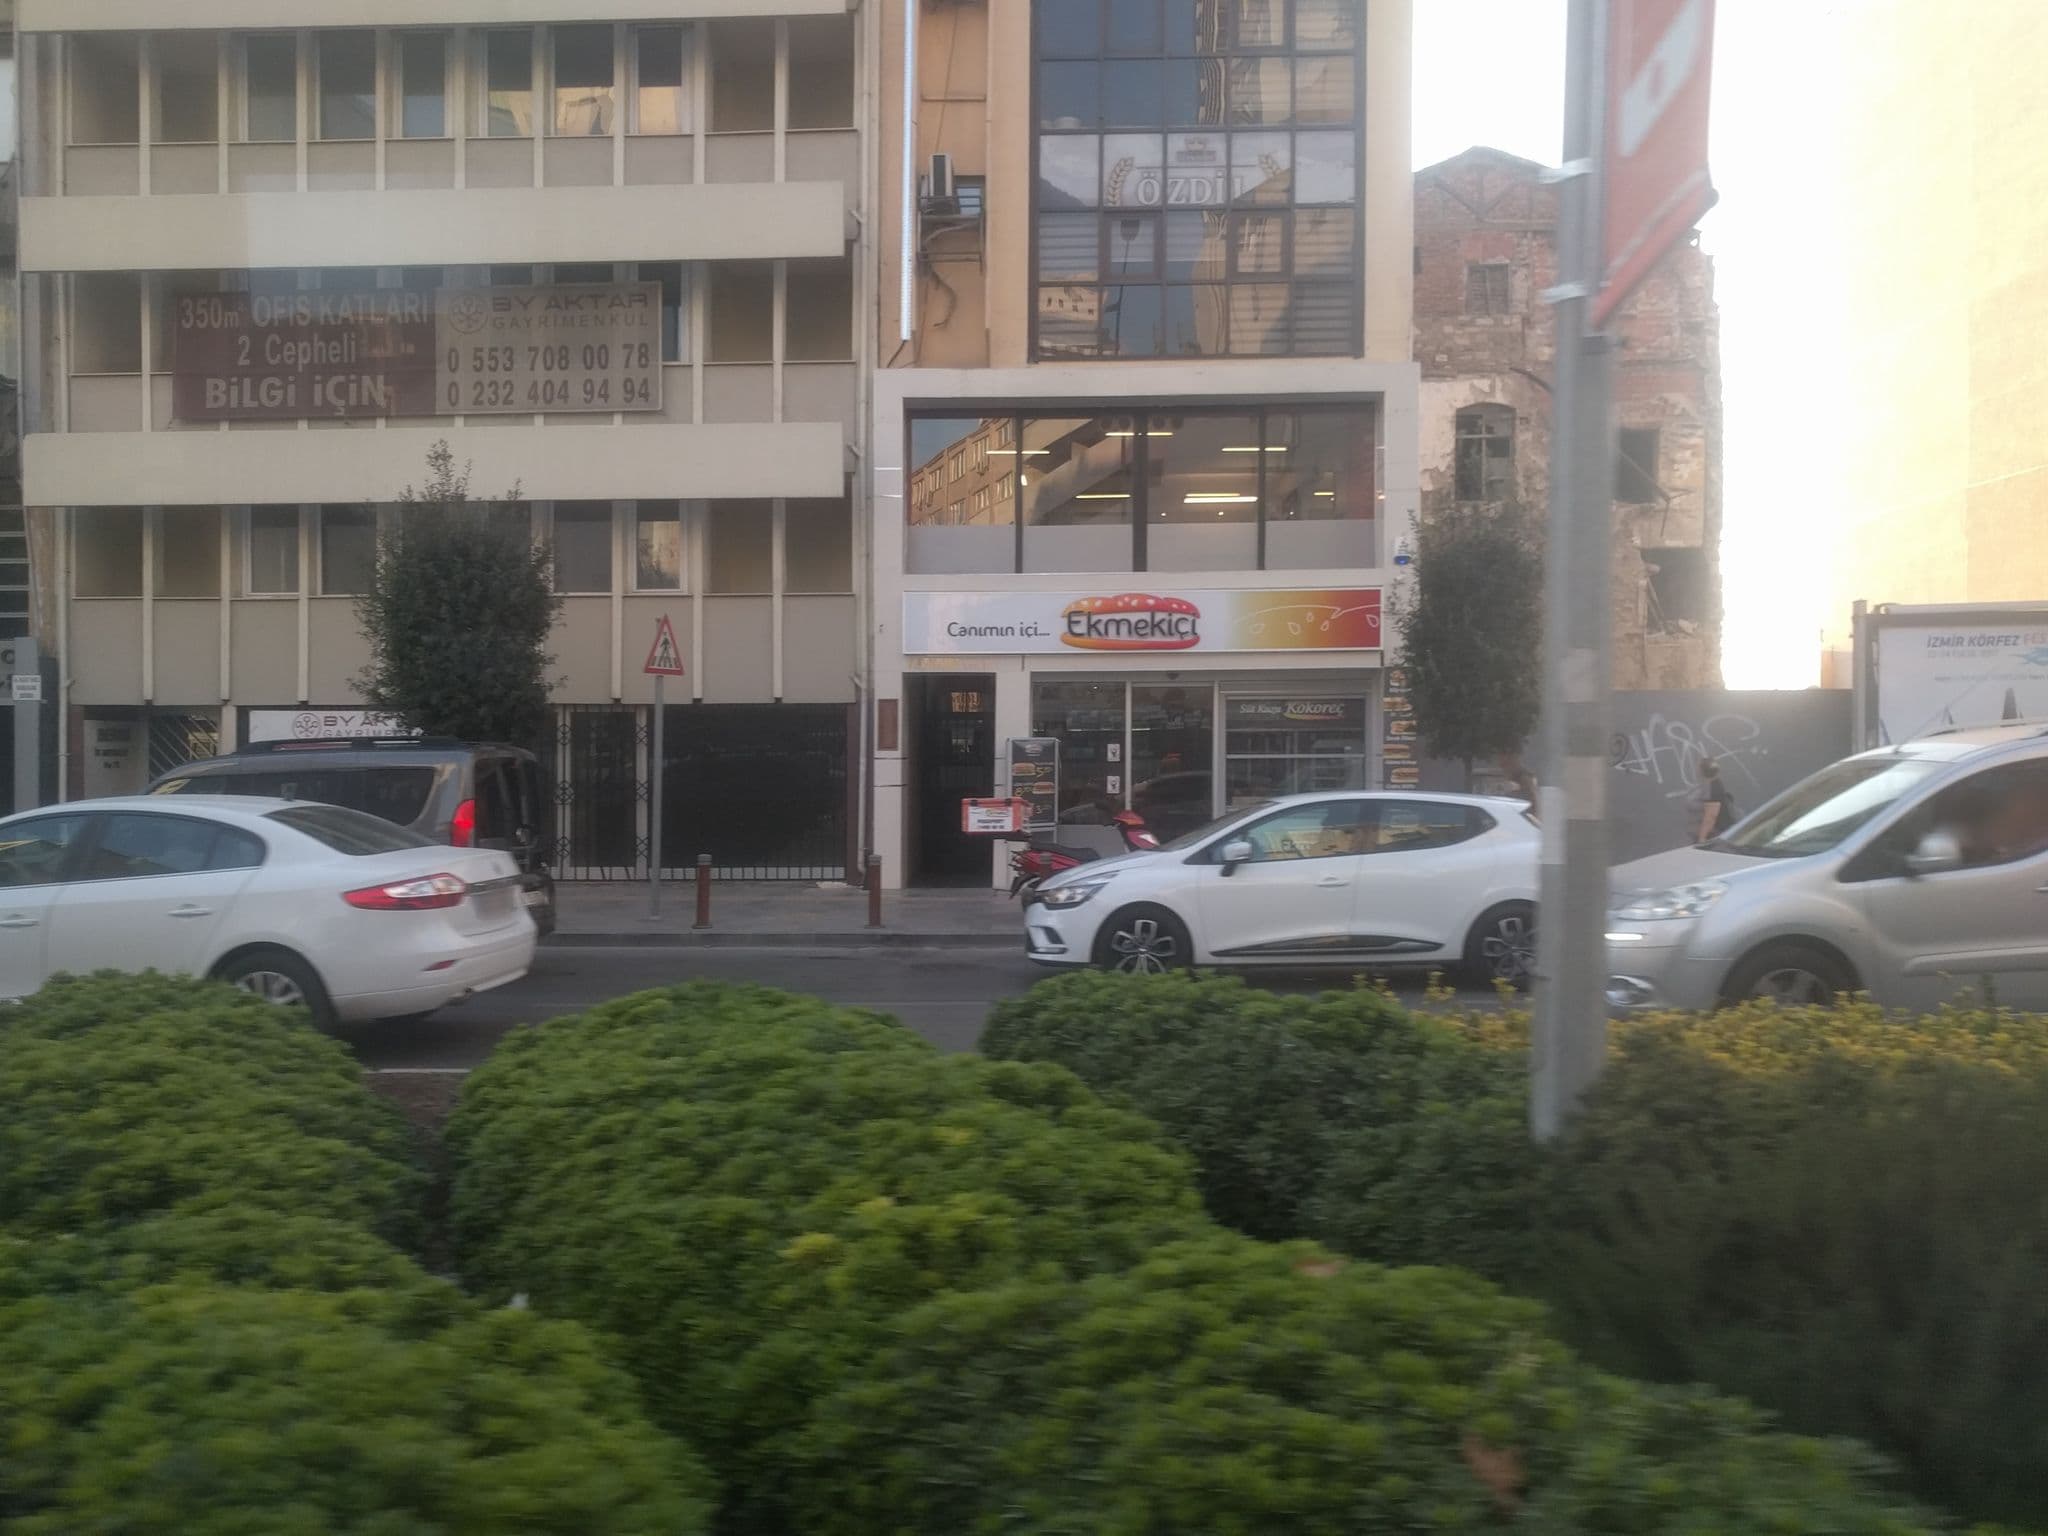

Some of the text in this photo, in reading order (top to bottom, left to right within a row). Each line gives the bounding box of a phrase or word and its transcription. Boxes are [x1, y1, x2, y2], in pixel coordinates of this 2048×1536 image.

[492, 293, 649, 313] BY AKTAR
[237, 332, 357, 373] 2 Cepheli
[448, 342, 650, 373] 0 553 708 00 78
[448, 377, 650, 407] 0 232 404 94 94
[947, 621, 1015, 637] Canımın
[1067, 610, 1198, 640] Ekmekiçi
[323, 715, 356, 727] BY
[1284, 702, 1345, 717] Kokoreç
